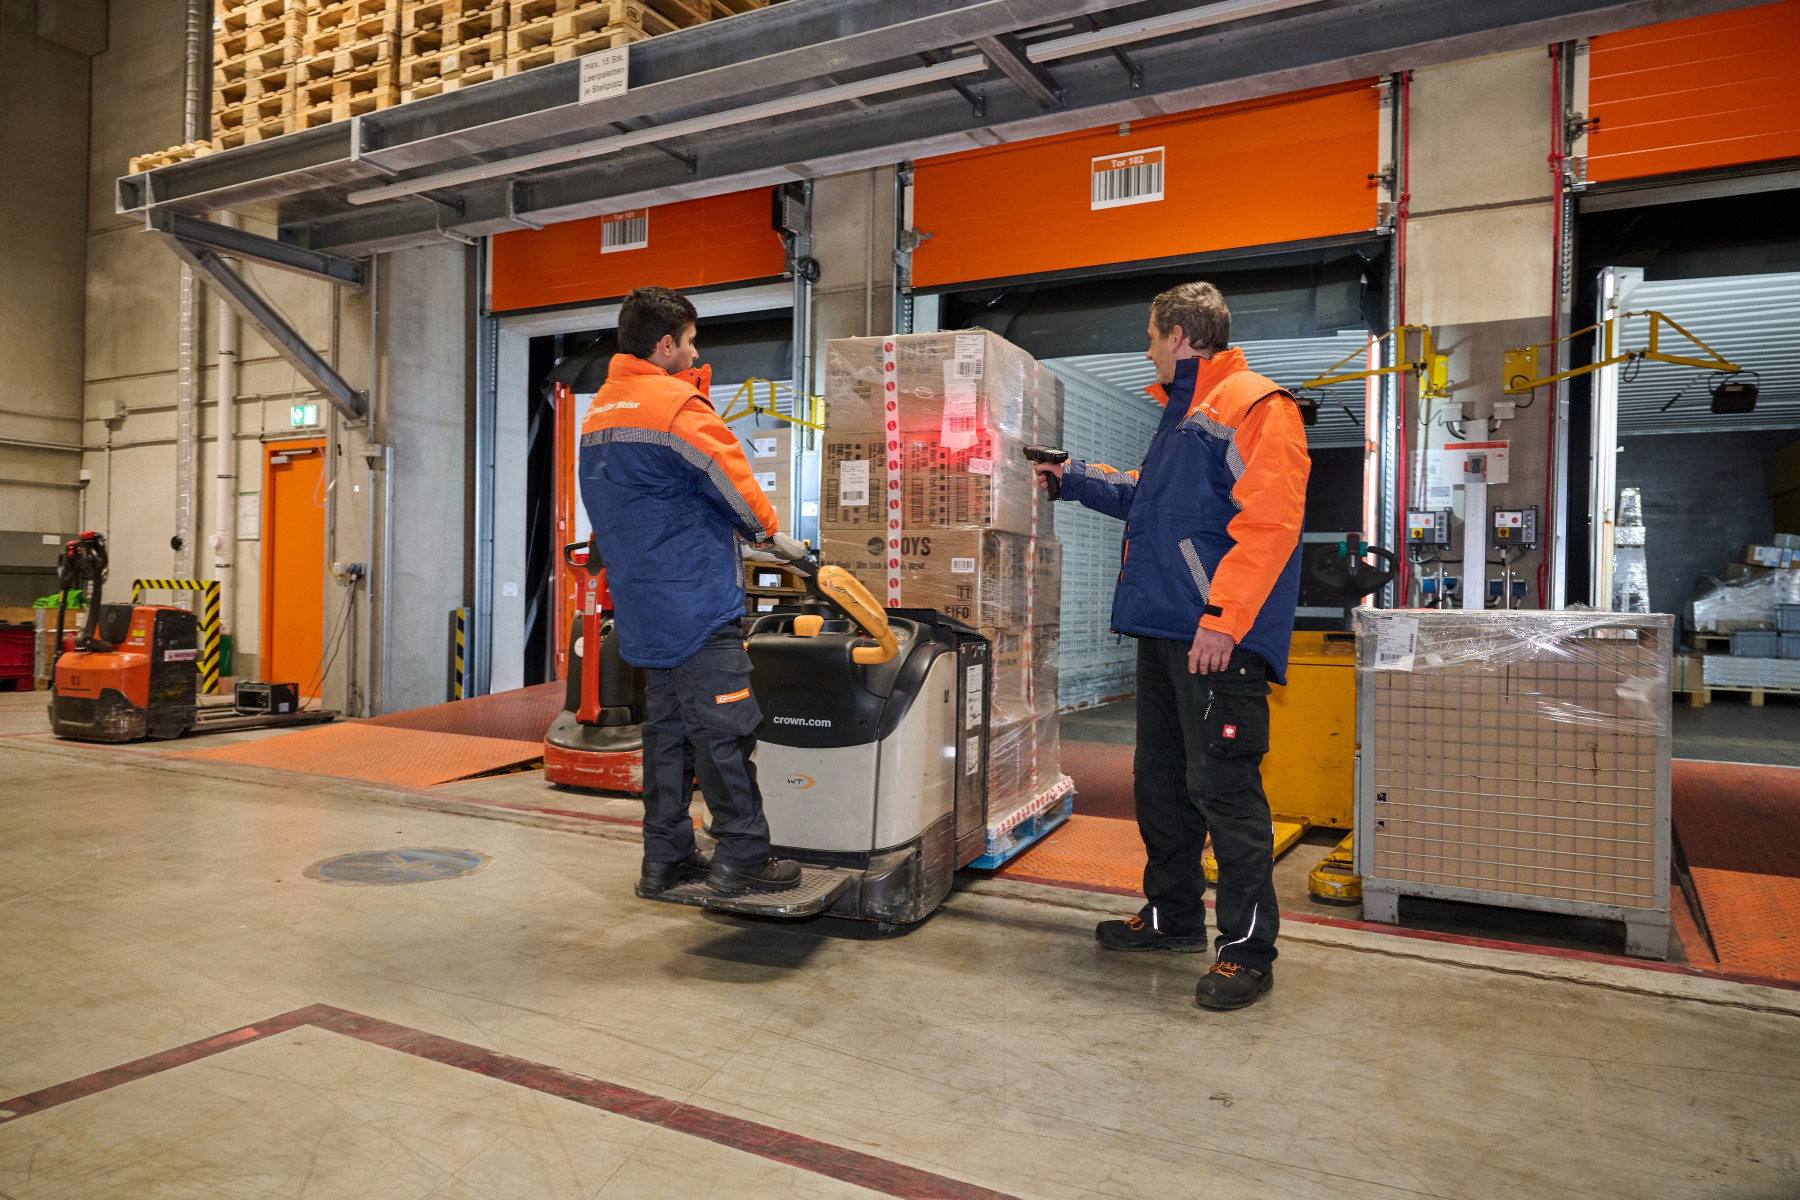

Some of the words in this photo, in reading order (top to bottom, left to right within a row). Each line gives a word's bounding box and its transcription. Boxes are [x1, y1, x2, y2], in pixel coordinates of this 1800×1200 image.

[602, 57, 610, 65] 15
[1110, 159, 1126, 168] Tor
[1128, 155, 1145, 165] 102
[900, 536, 932, 556] OYS
[773, 716, 832, 728] crown.com
